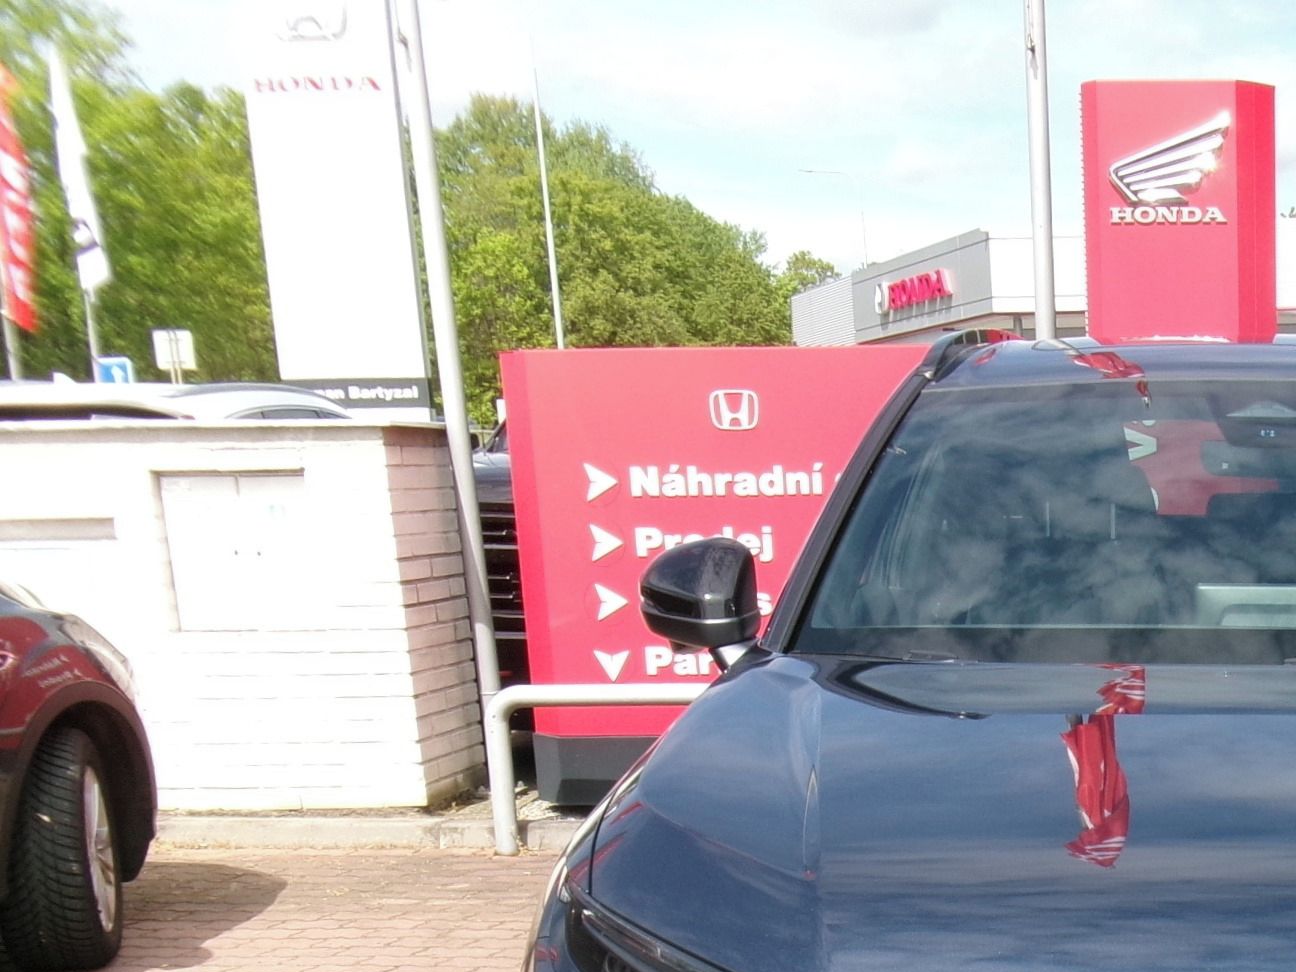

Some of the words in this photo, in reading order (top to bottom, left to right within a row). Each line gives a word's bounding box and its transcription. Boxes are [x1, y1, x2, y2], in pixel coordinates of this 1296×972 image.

[1109, 206, 1228, 224] HONDA
[347, 385, 419, 400] Bartyzal
[628, 463, 823, 497] Náhradní
[644, 646, 720, 676] Par
